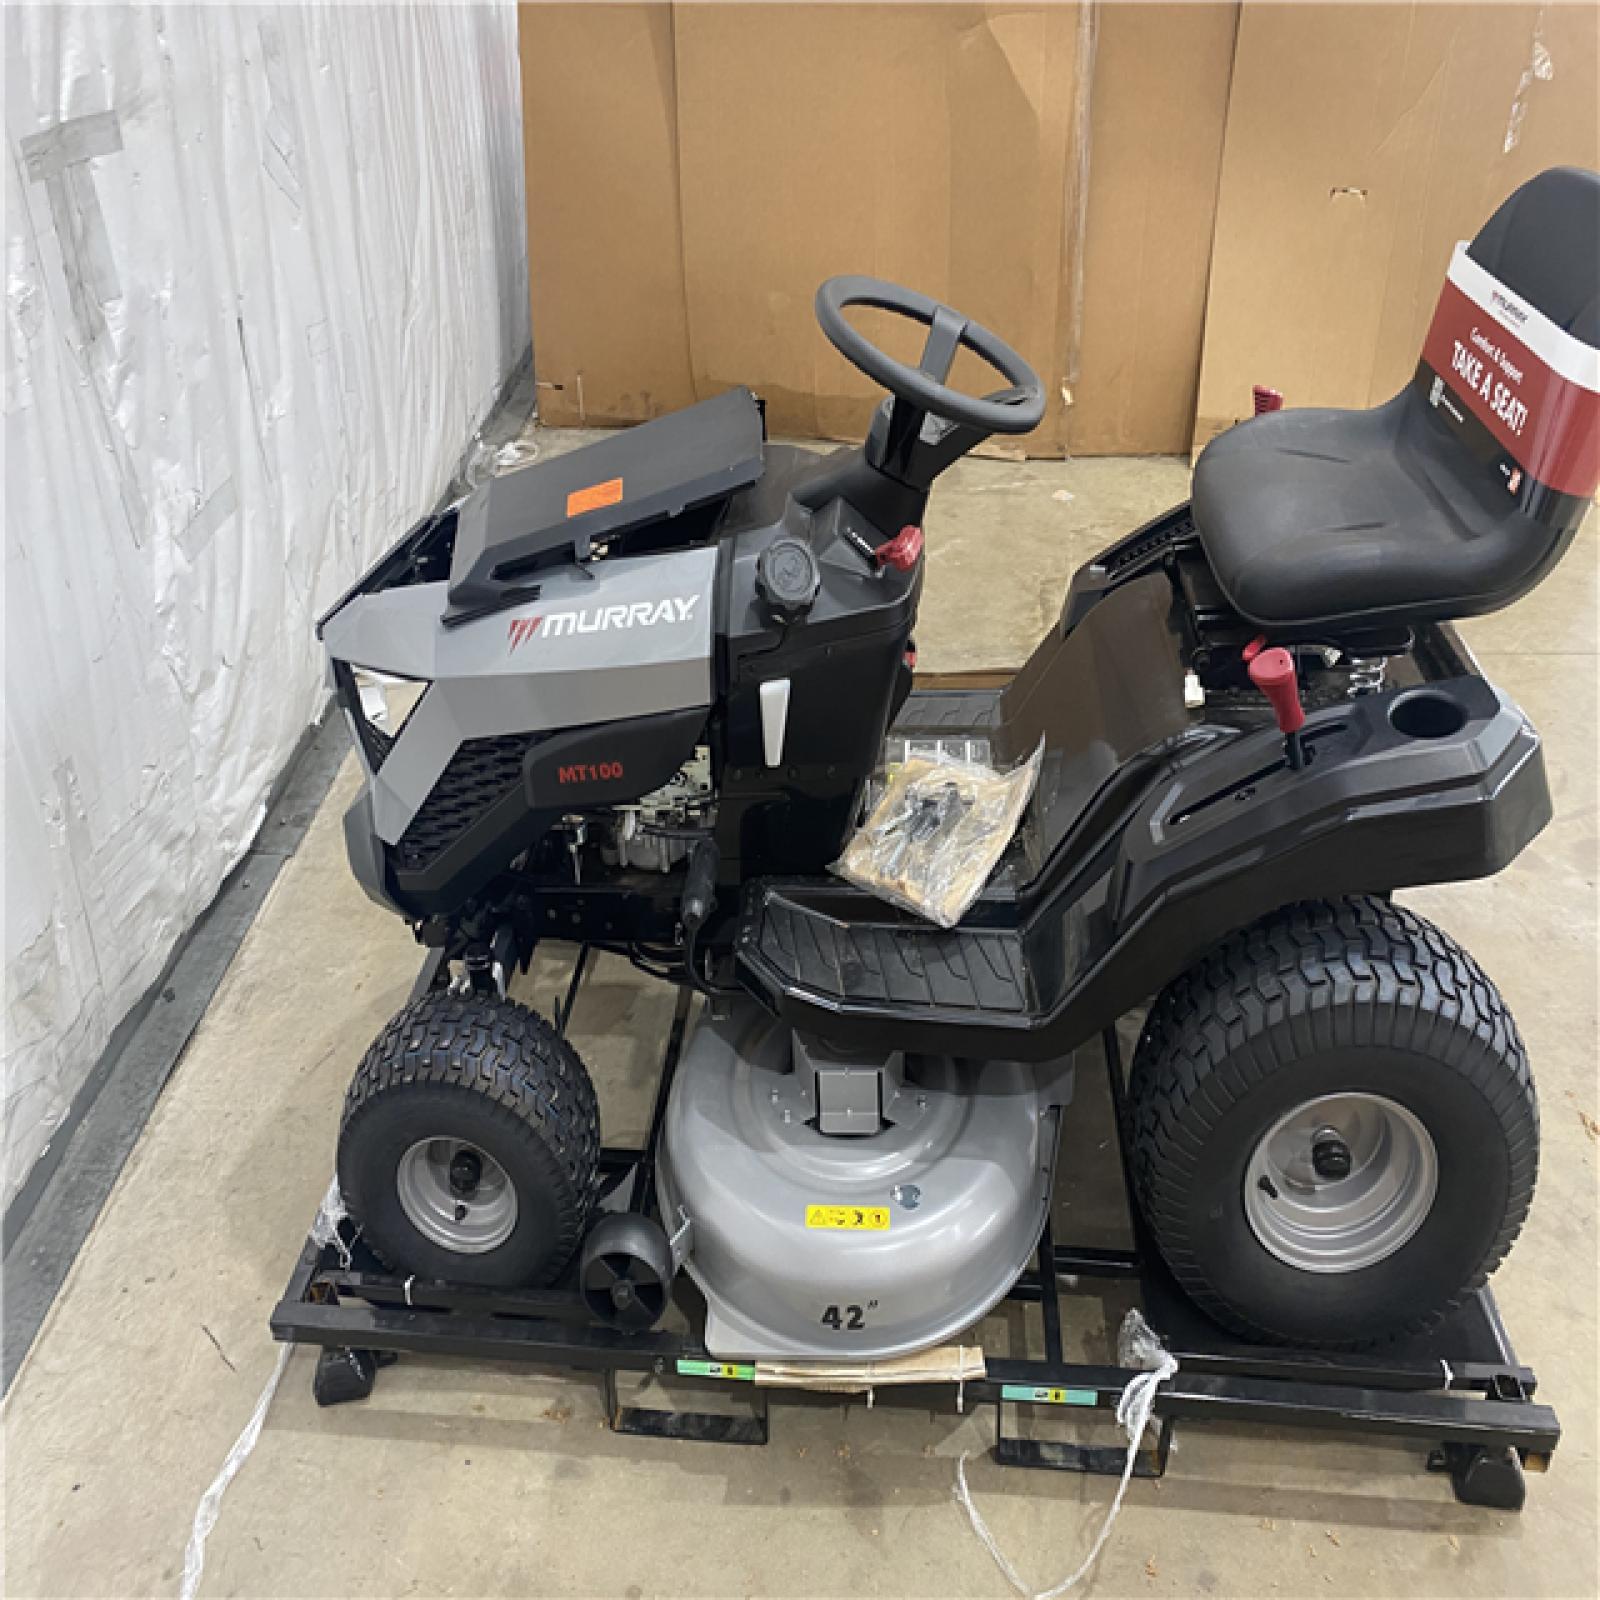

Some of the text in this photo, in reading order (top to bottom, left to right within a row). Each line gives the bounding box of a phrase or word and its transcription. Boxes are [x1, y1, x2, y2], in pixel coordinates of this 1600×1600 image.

[1452, 340, 1483, 389] TAKE
[1479, 372, 1493, 402] A
[1490, 382, 1528, 436] SEAT!
[558, 761, 624, 784] MT100
